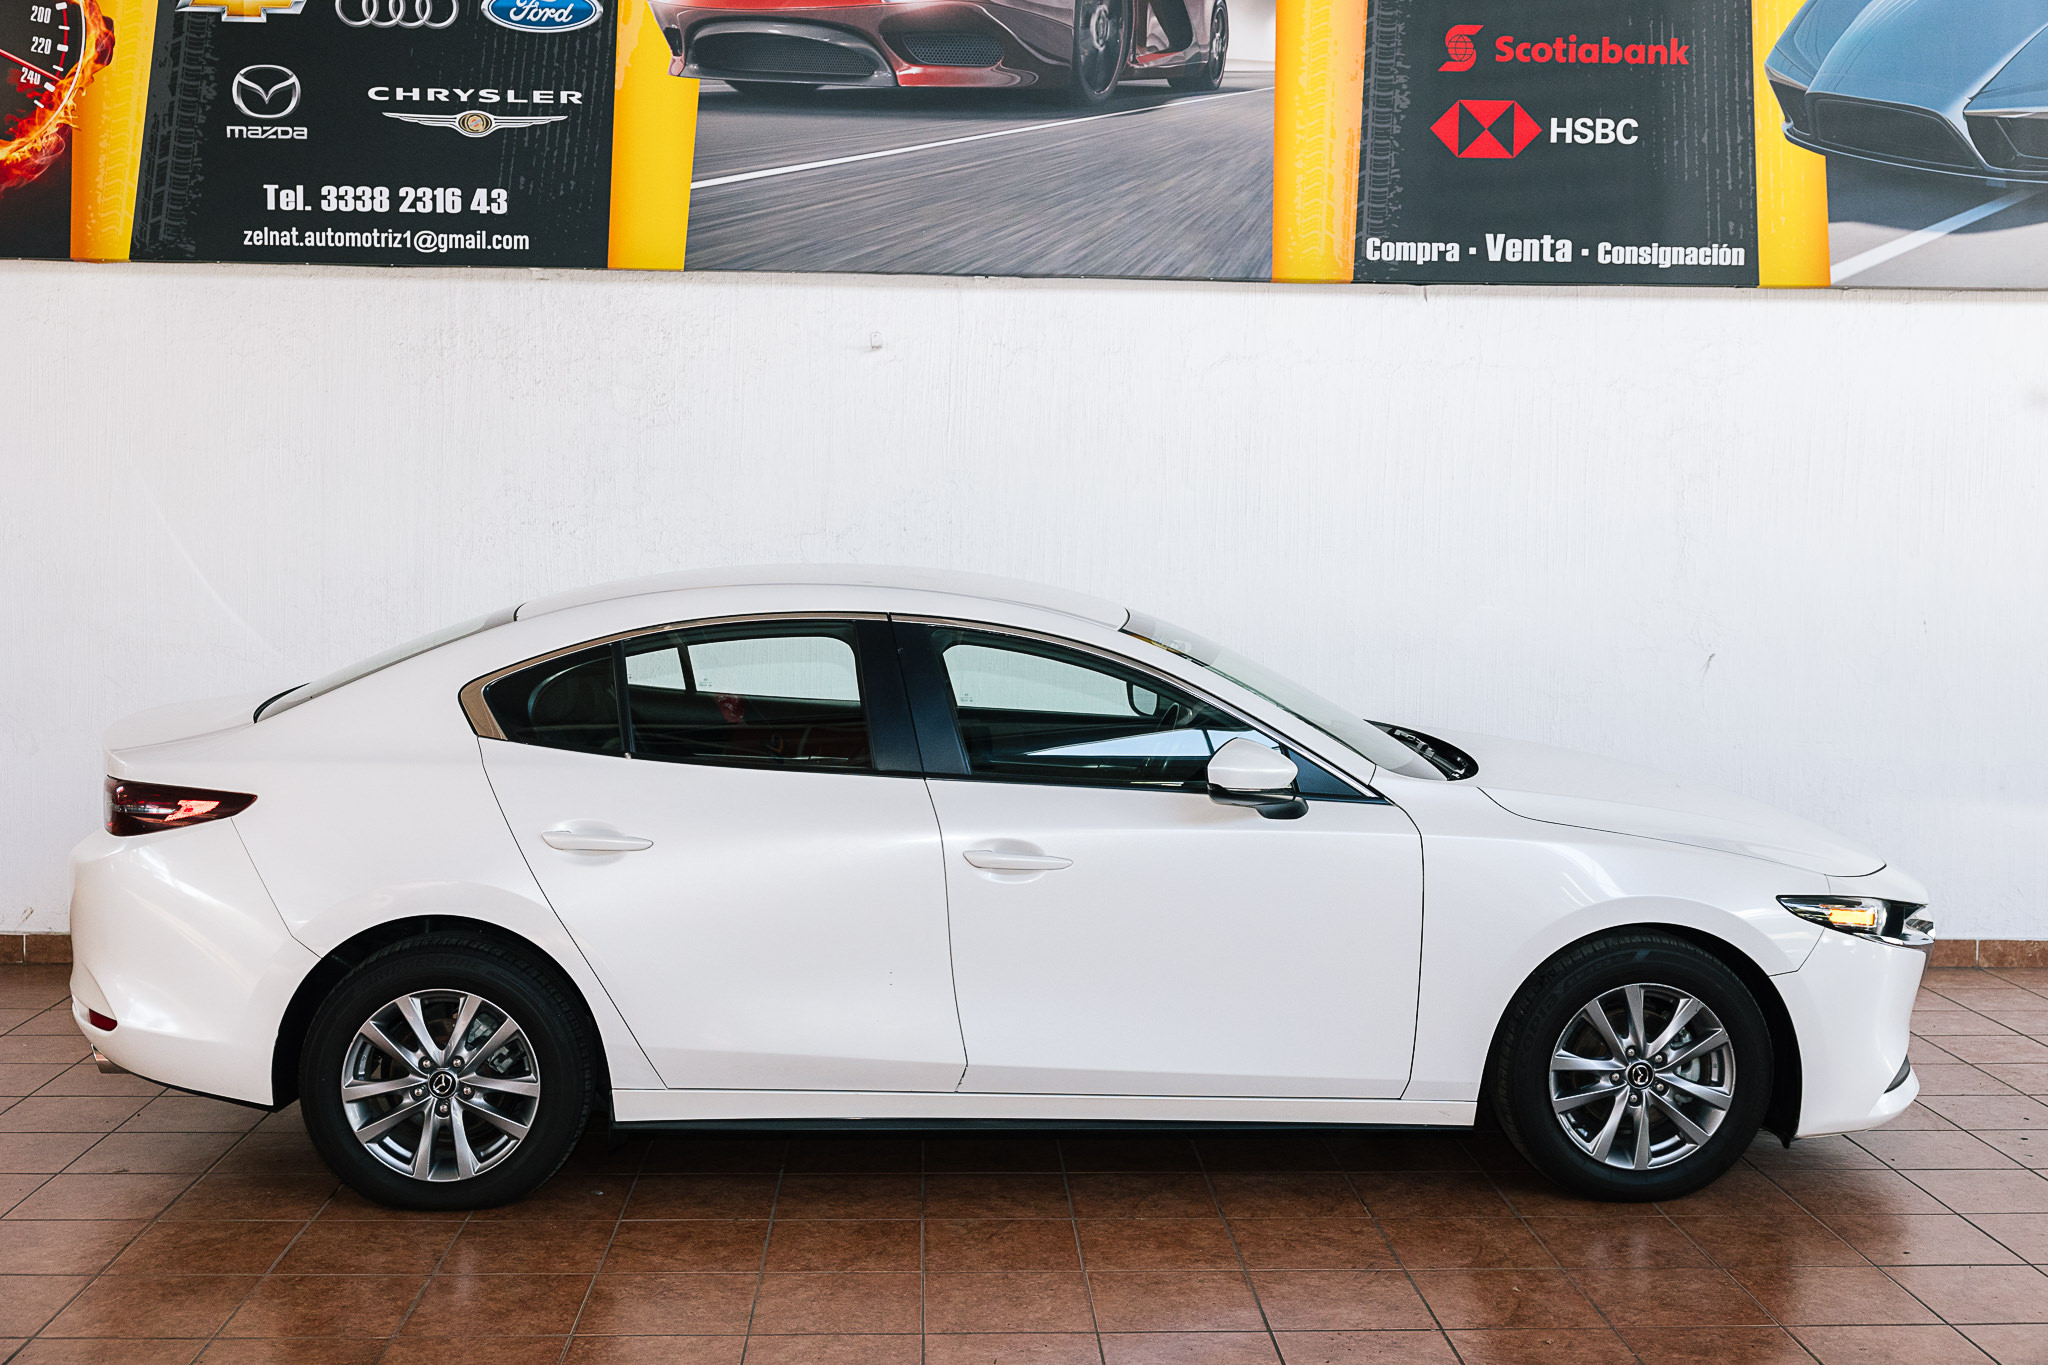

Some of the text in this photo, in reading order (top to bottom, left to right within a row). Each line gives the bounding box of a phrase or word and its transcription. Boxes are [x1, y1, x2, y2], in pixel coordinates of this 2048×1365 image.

[30, 5, 52, 24] 200
[509, 0, 575, 22] Ford
[30, 36, 52, 55] 220
[1495, 34, 1690, 65] Scotiabank
[20, 66, 41, 85] 240
[367, 87, 583, 105] CHRYSLER
[226, 125, 308, 140] mazda
[1549, 117, 1639, 145] HSBC
[262, 184, 508, 215] Tel. 3338 2316 43
[243, 226, 530, 253] zelnat.automotriz1@gmail.com
[1365, 233, 1746, 269] Compra Venta Consignación
